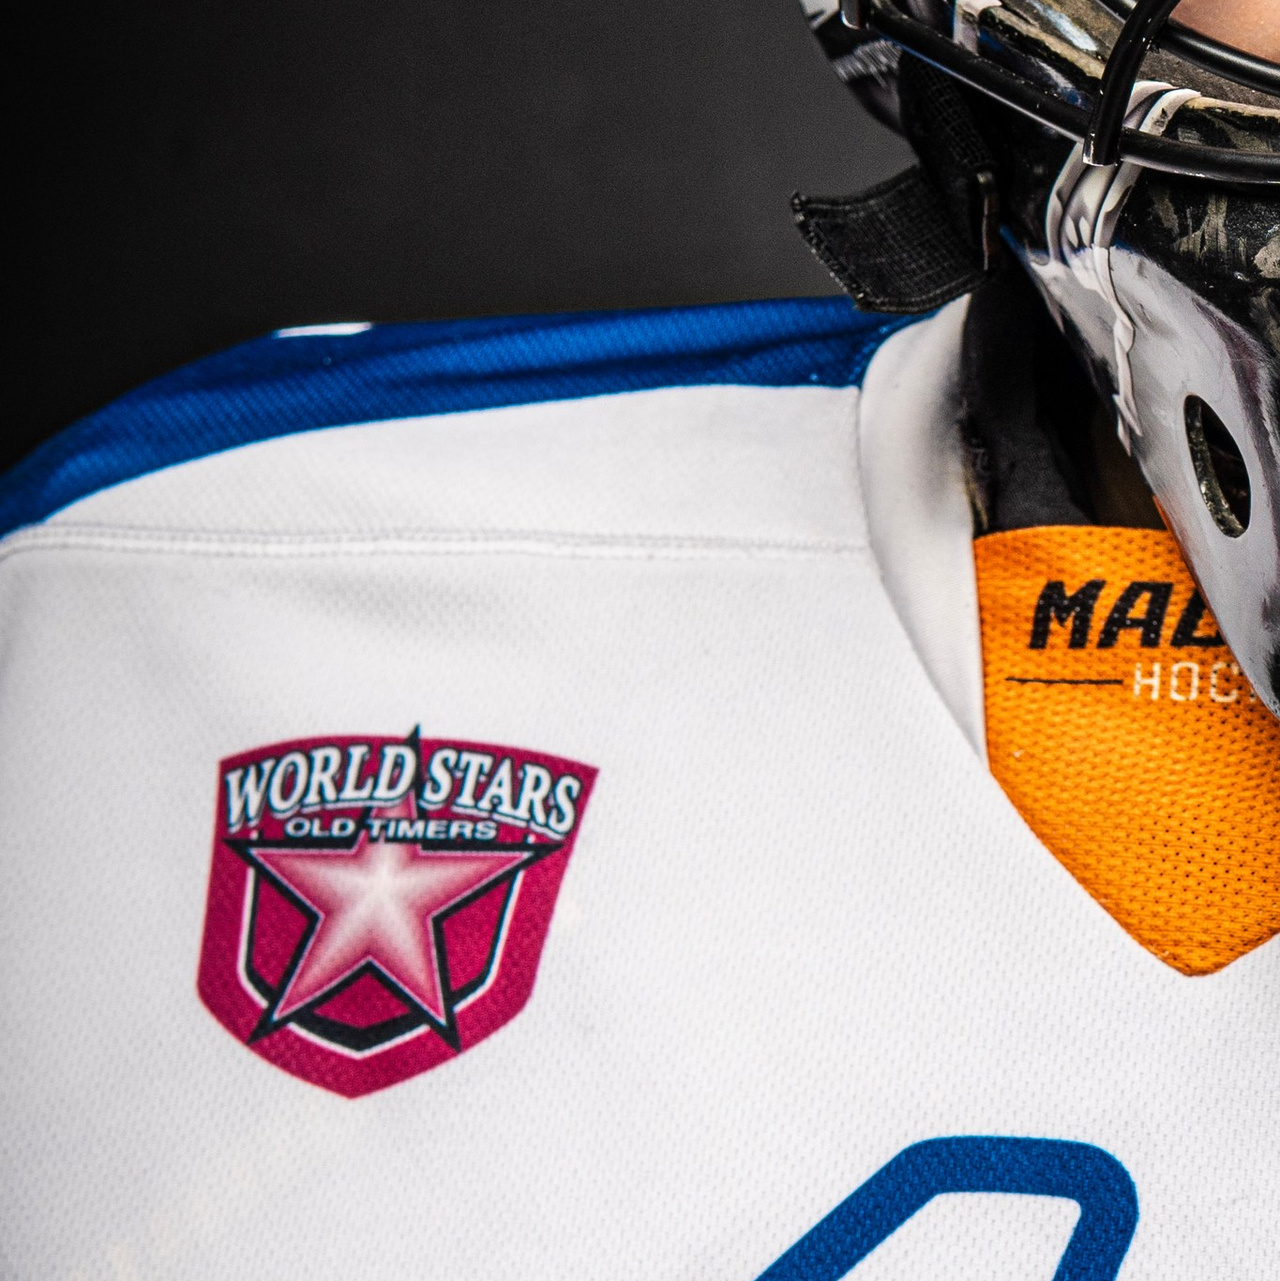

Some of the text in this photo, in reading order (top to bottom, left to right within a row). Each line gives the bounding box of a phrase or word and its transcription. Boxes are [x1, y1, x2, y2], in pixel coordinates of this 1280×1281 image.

[1133, 661, 1258, 703] HOC
[224, 743, 582, 840] WORLD STARS
[284, 817, 498, 841] OLD TIMERS
